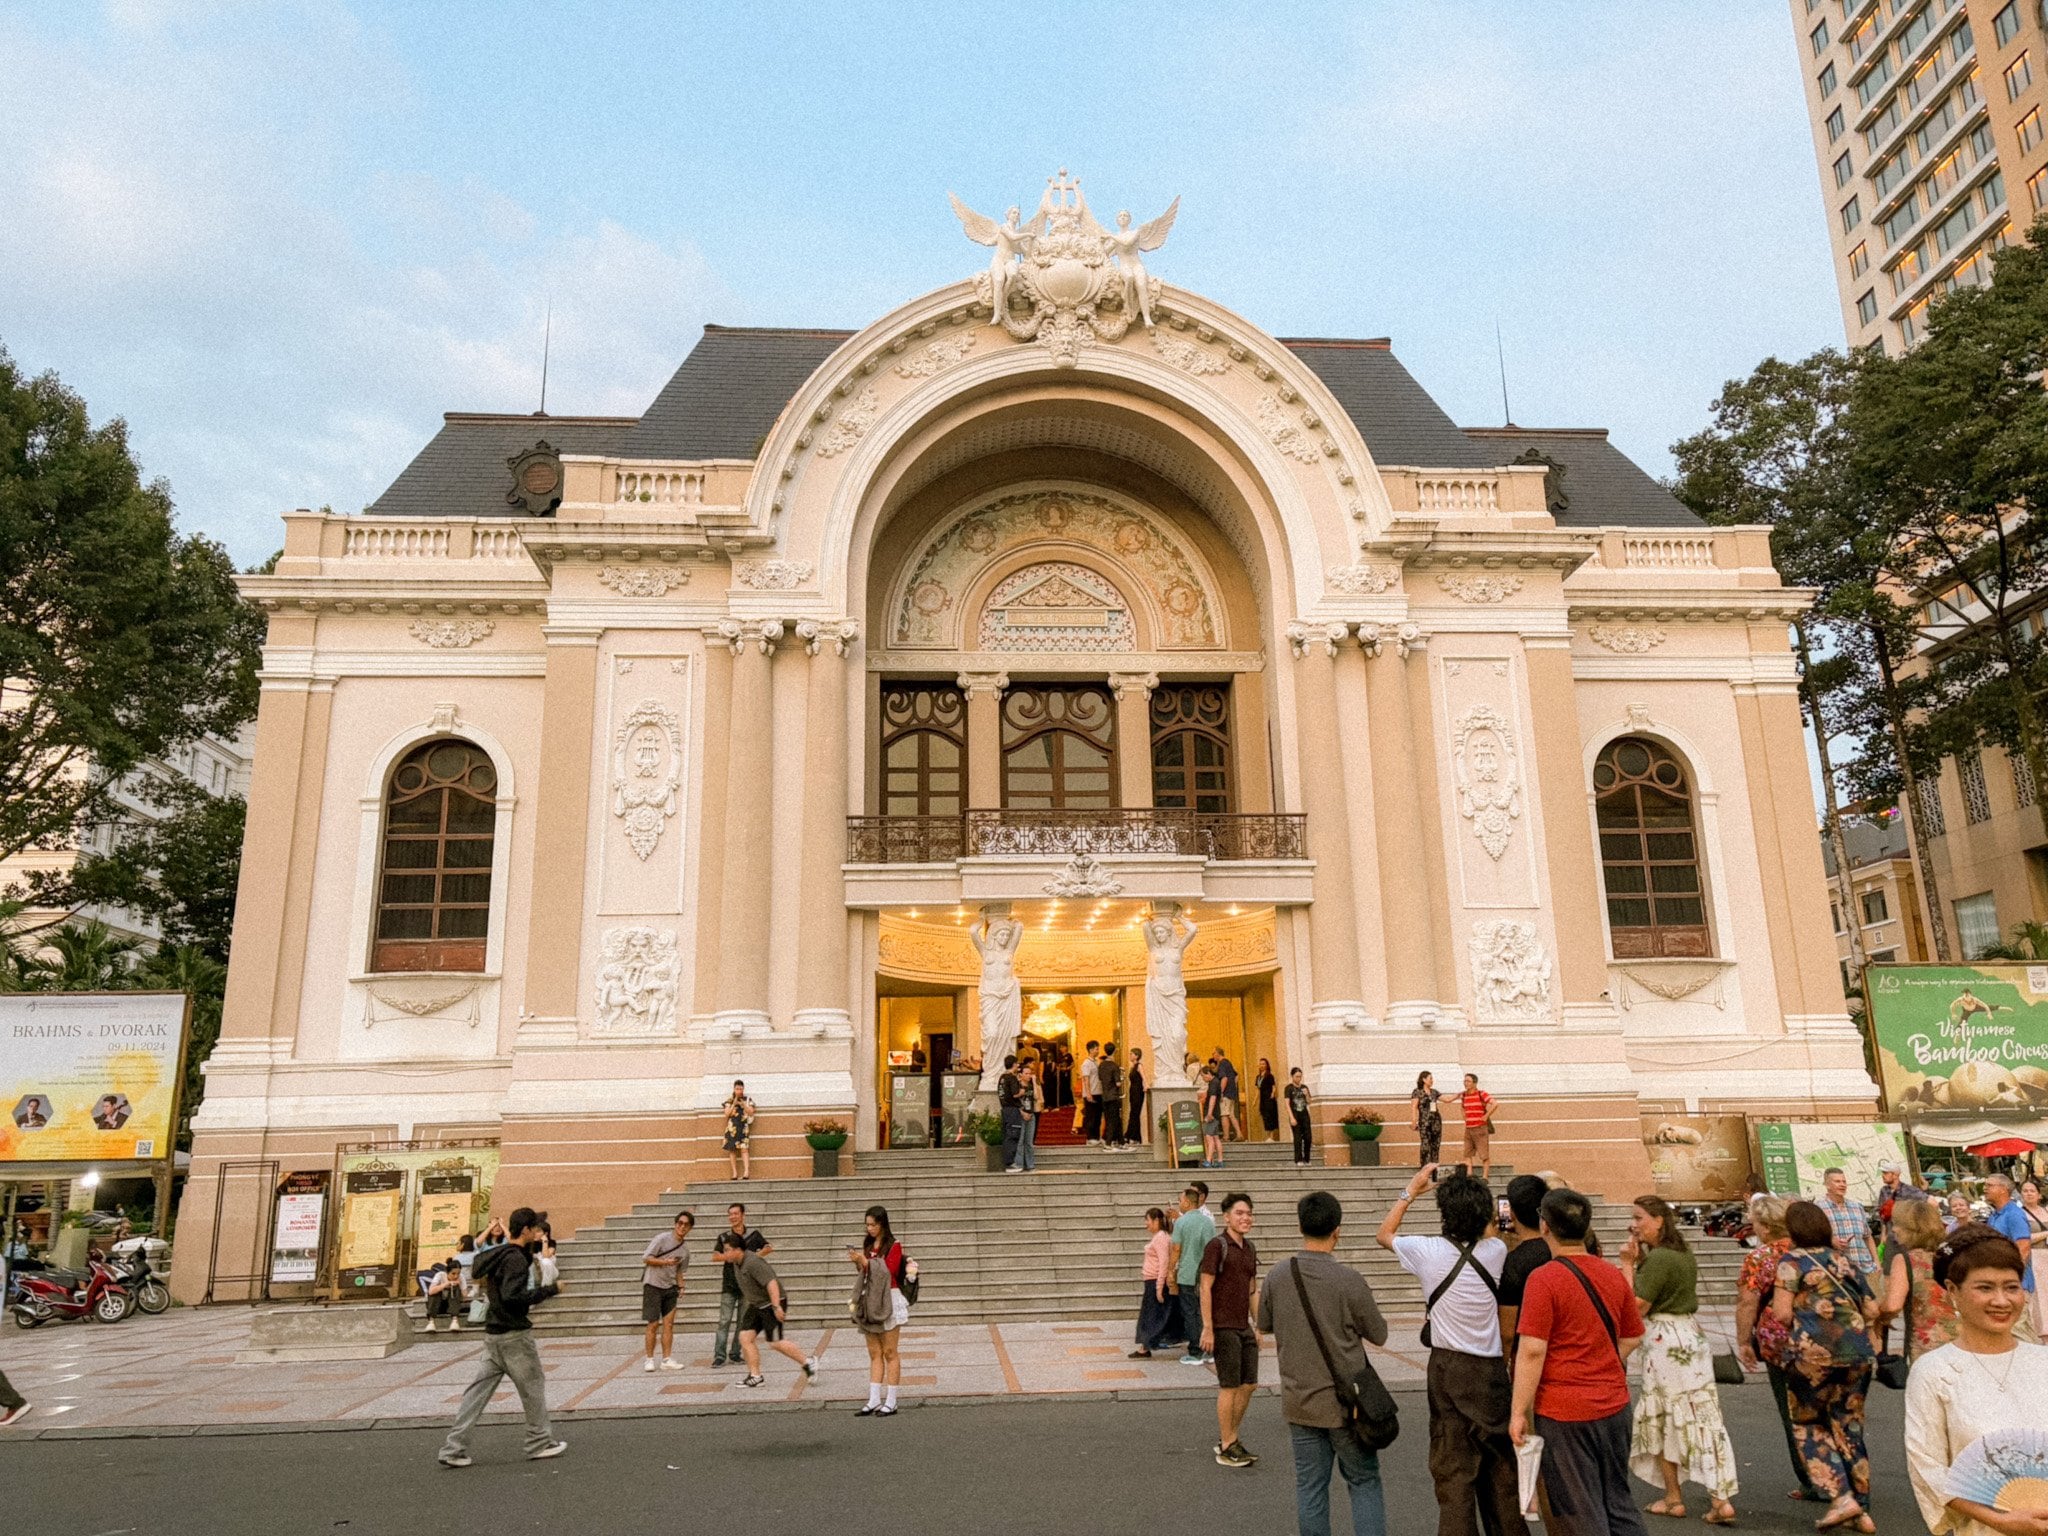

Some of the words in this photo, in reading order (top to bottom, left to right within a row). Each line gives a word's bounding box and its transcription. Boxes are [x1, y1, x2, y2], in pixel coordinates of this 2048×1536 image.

[12, 1024, 82, 1038] BRAHMS
[99, 1023, 168, 1037] DVORAK
[1936, 1018, 2016, 1041] Vietnamese
[107, 1041, 166, 1051] 09.11.2024
[1907, 1033, 2000, 1065] Bamboo
[2002, 1039, 2048, 1061] Circus
